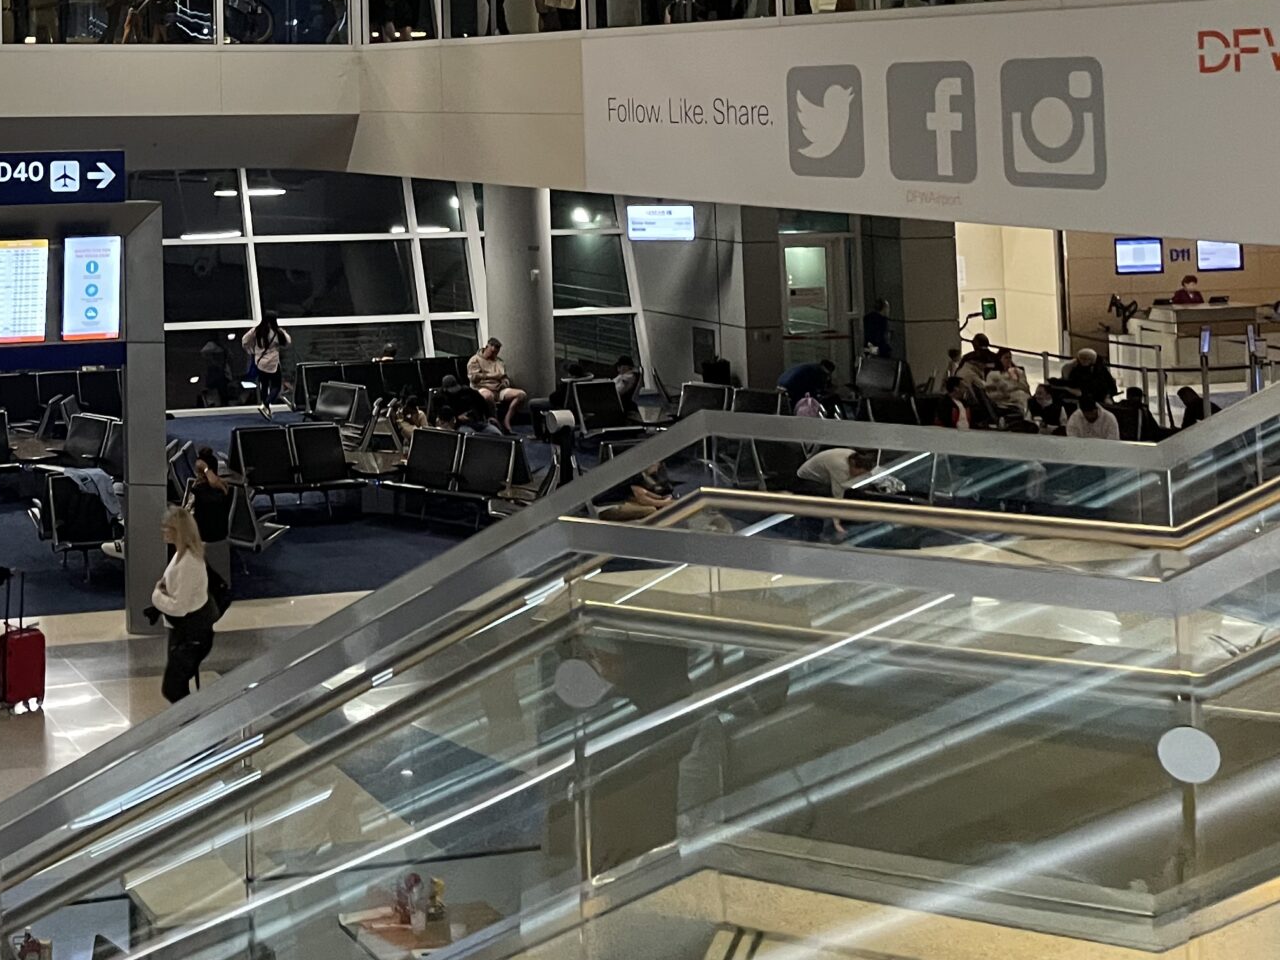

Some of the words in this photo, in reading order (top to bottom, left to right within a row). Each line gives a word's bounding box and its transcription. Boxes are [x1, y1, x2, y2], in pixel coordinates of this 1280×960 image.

[608, 97, 663, 123] Follow.
[669, 97, 708, 125] Like.
[713, 98, 774, 126] Share.
[1170, 248, 1191, 262] D11
